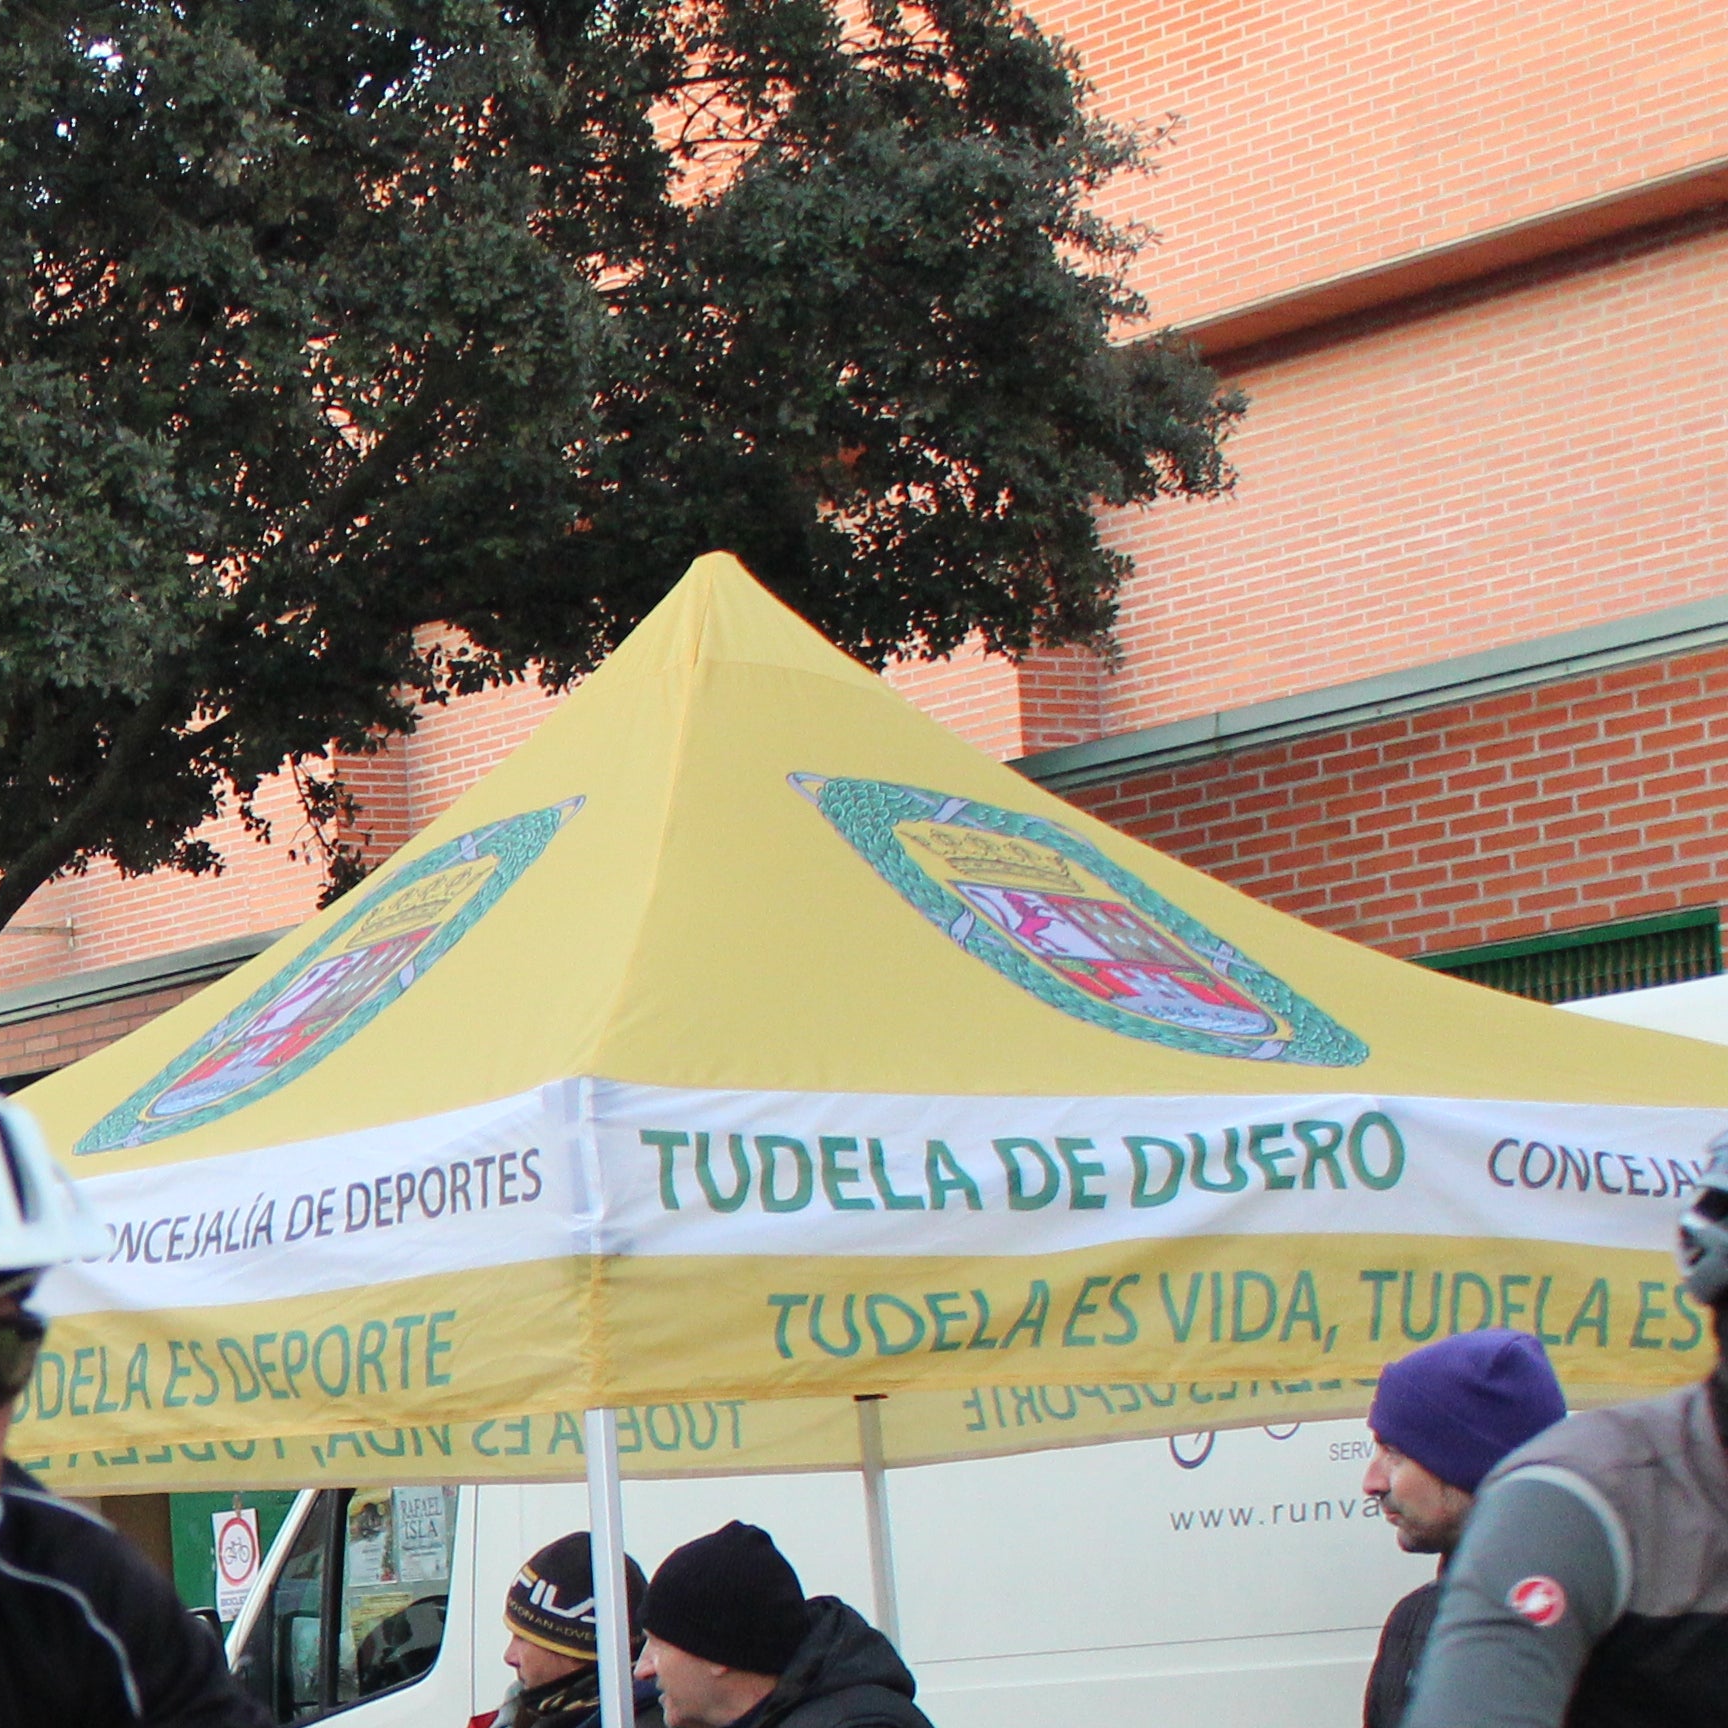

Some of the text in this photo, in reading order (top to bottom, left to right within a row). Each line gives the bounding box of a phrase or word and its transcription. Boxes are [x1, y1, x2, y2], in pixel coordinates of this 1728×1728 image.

[284, 1187, 338, 1242] DE
[344, 1148, 542, 1233] DEPORTES
[641, 1111, 1405, 1214] TUDELA DE DUERO
[163, 1338, 221, 1407] ES
[218, 1308, 457, 1404] DEPORTE
[768, 1270, 1704, 1360] TUDELA ES VIDA, TUDELA ES
[403, 1518, 439, 1541] ISLA
